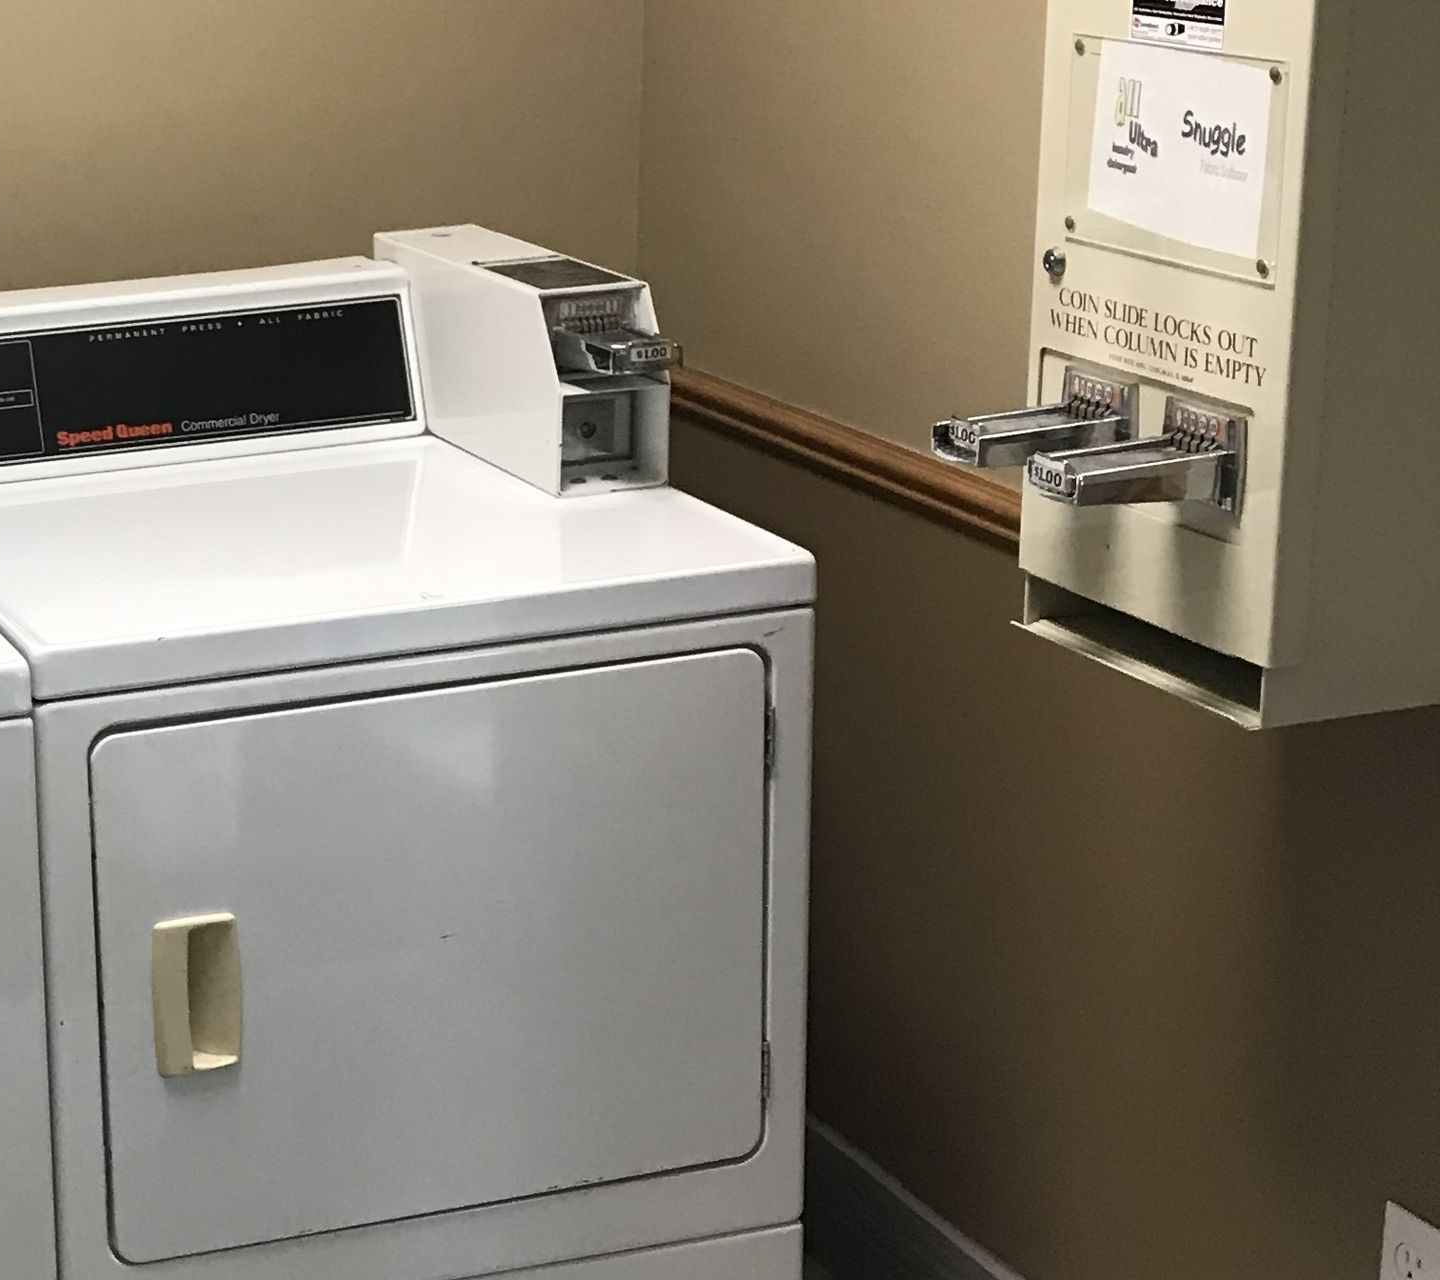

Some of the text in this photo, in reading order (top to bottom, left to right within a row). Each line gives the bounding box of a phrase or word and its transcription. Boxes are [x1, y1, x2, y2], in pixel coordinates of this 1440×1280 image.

[1129, 120, 1158, 158] Ultra
[1181, 110, 1246, 158] Snuggle
[89, 328, 166, 342] PERMANENT
[1059, 287, 1258, 358] COIN SLIDE LOCKS OUT
[1050, 308, 1098, 339] WHEN
[1104, 325, 1178, 363] COLUMN
[1183, 347, 1198, 369] IS
[1204, 352, 1267, 387] EMPTY
[56, 412, 280, 446] Speed Queen Commercial Dryer
